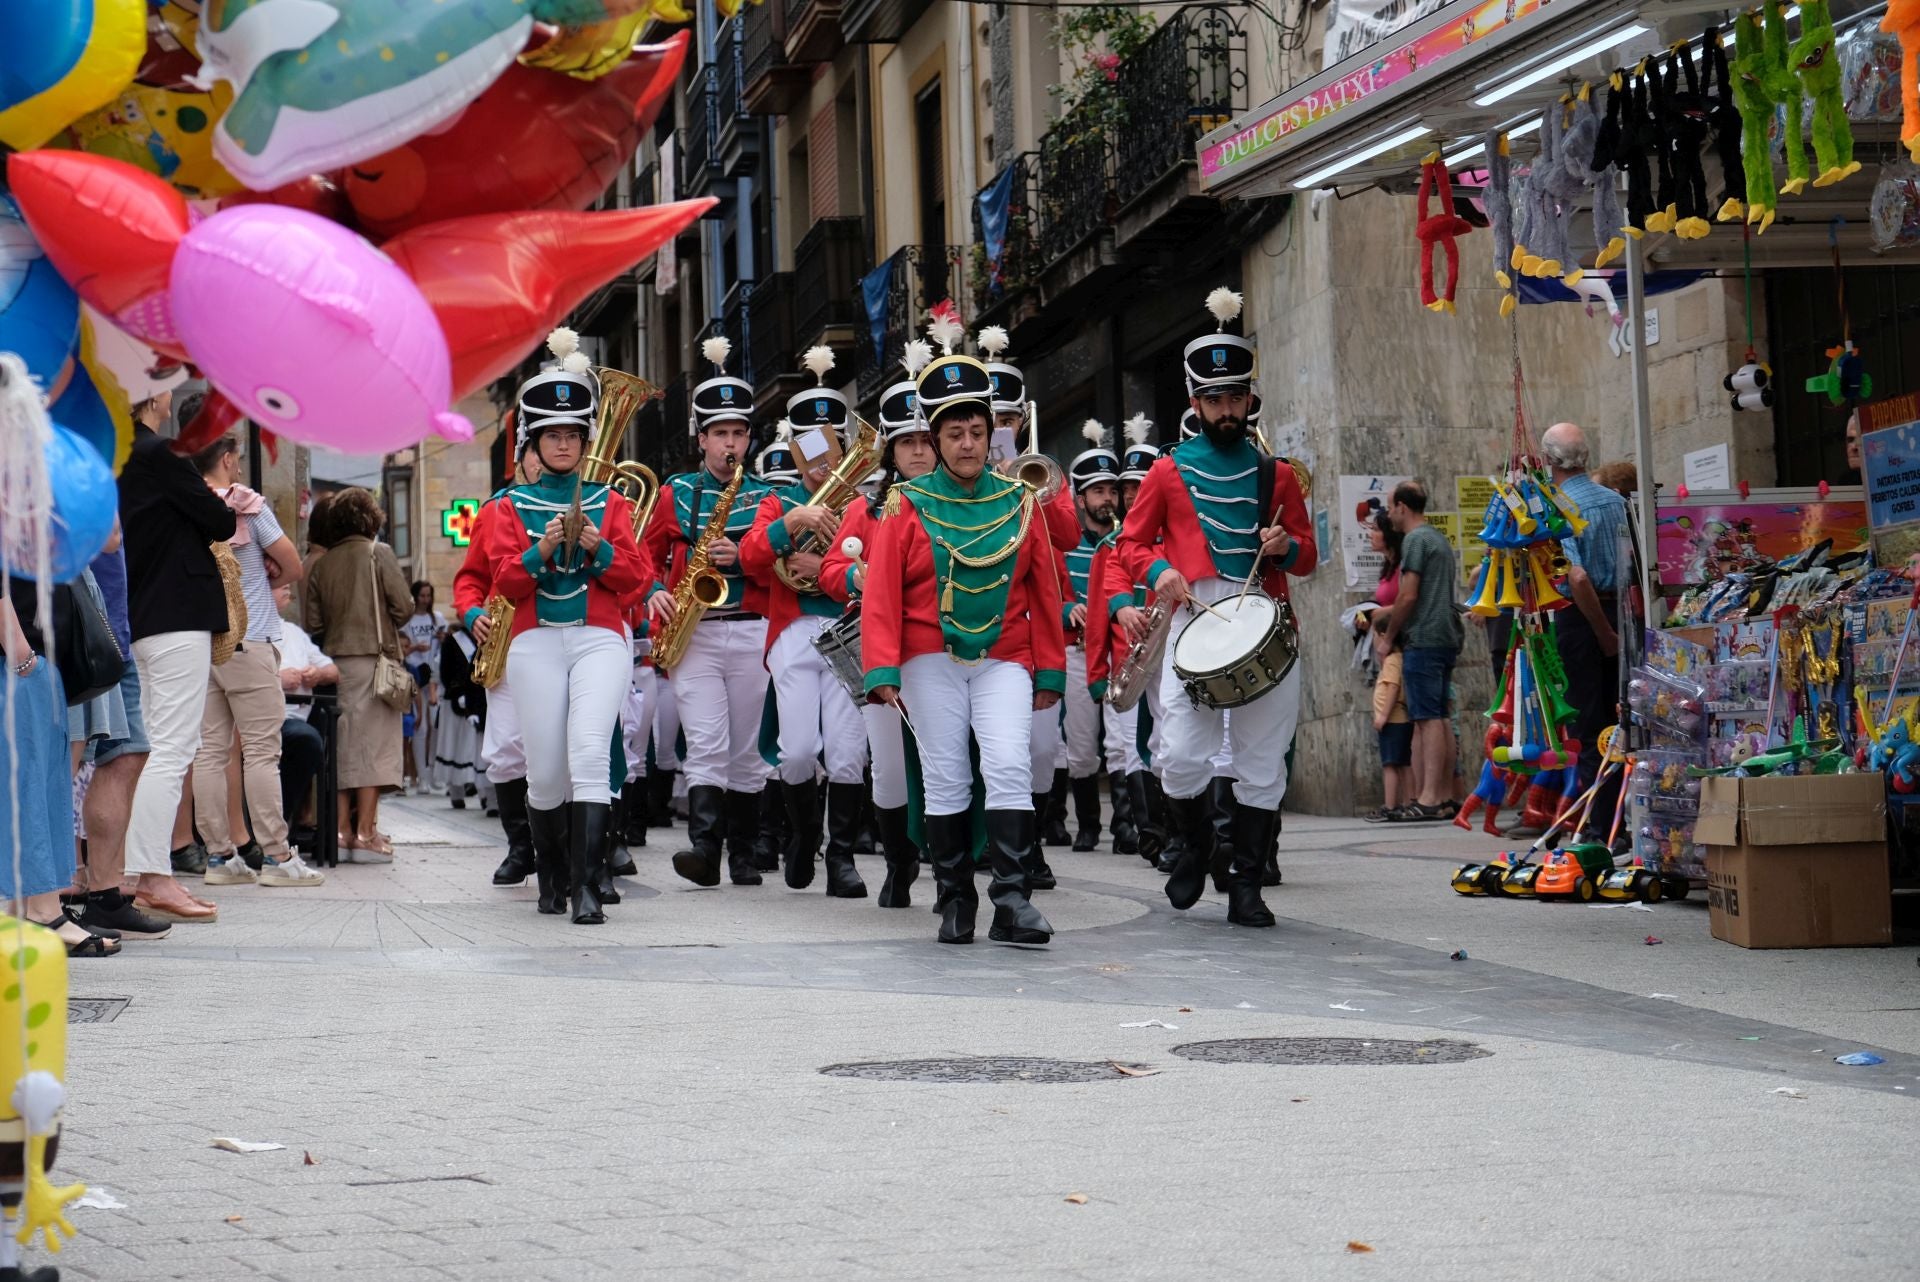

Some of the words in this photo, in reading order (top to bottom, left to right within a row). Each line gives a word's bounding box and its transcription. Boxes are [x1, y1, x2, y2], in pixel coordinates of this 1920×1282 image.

[1220, 105, 1301, 167] DULCES
[1302, 67, 1378, 122] PATXI
[1870, 395, 1918, 431] POPCORN
[1876, 473, 1901, 488] PATATAS
[1870, 488, 1898, 504] PERRITOS
[1891, 499, 1916, 514] GOFRES
